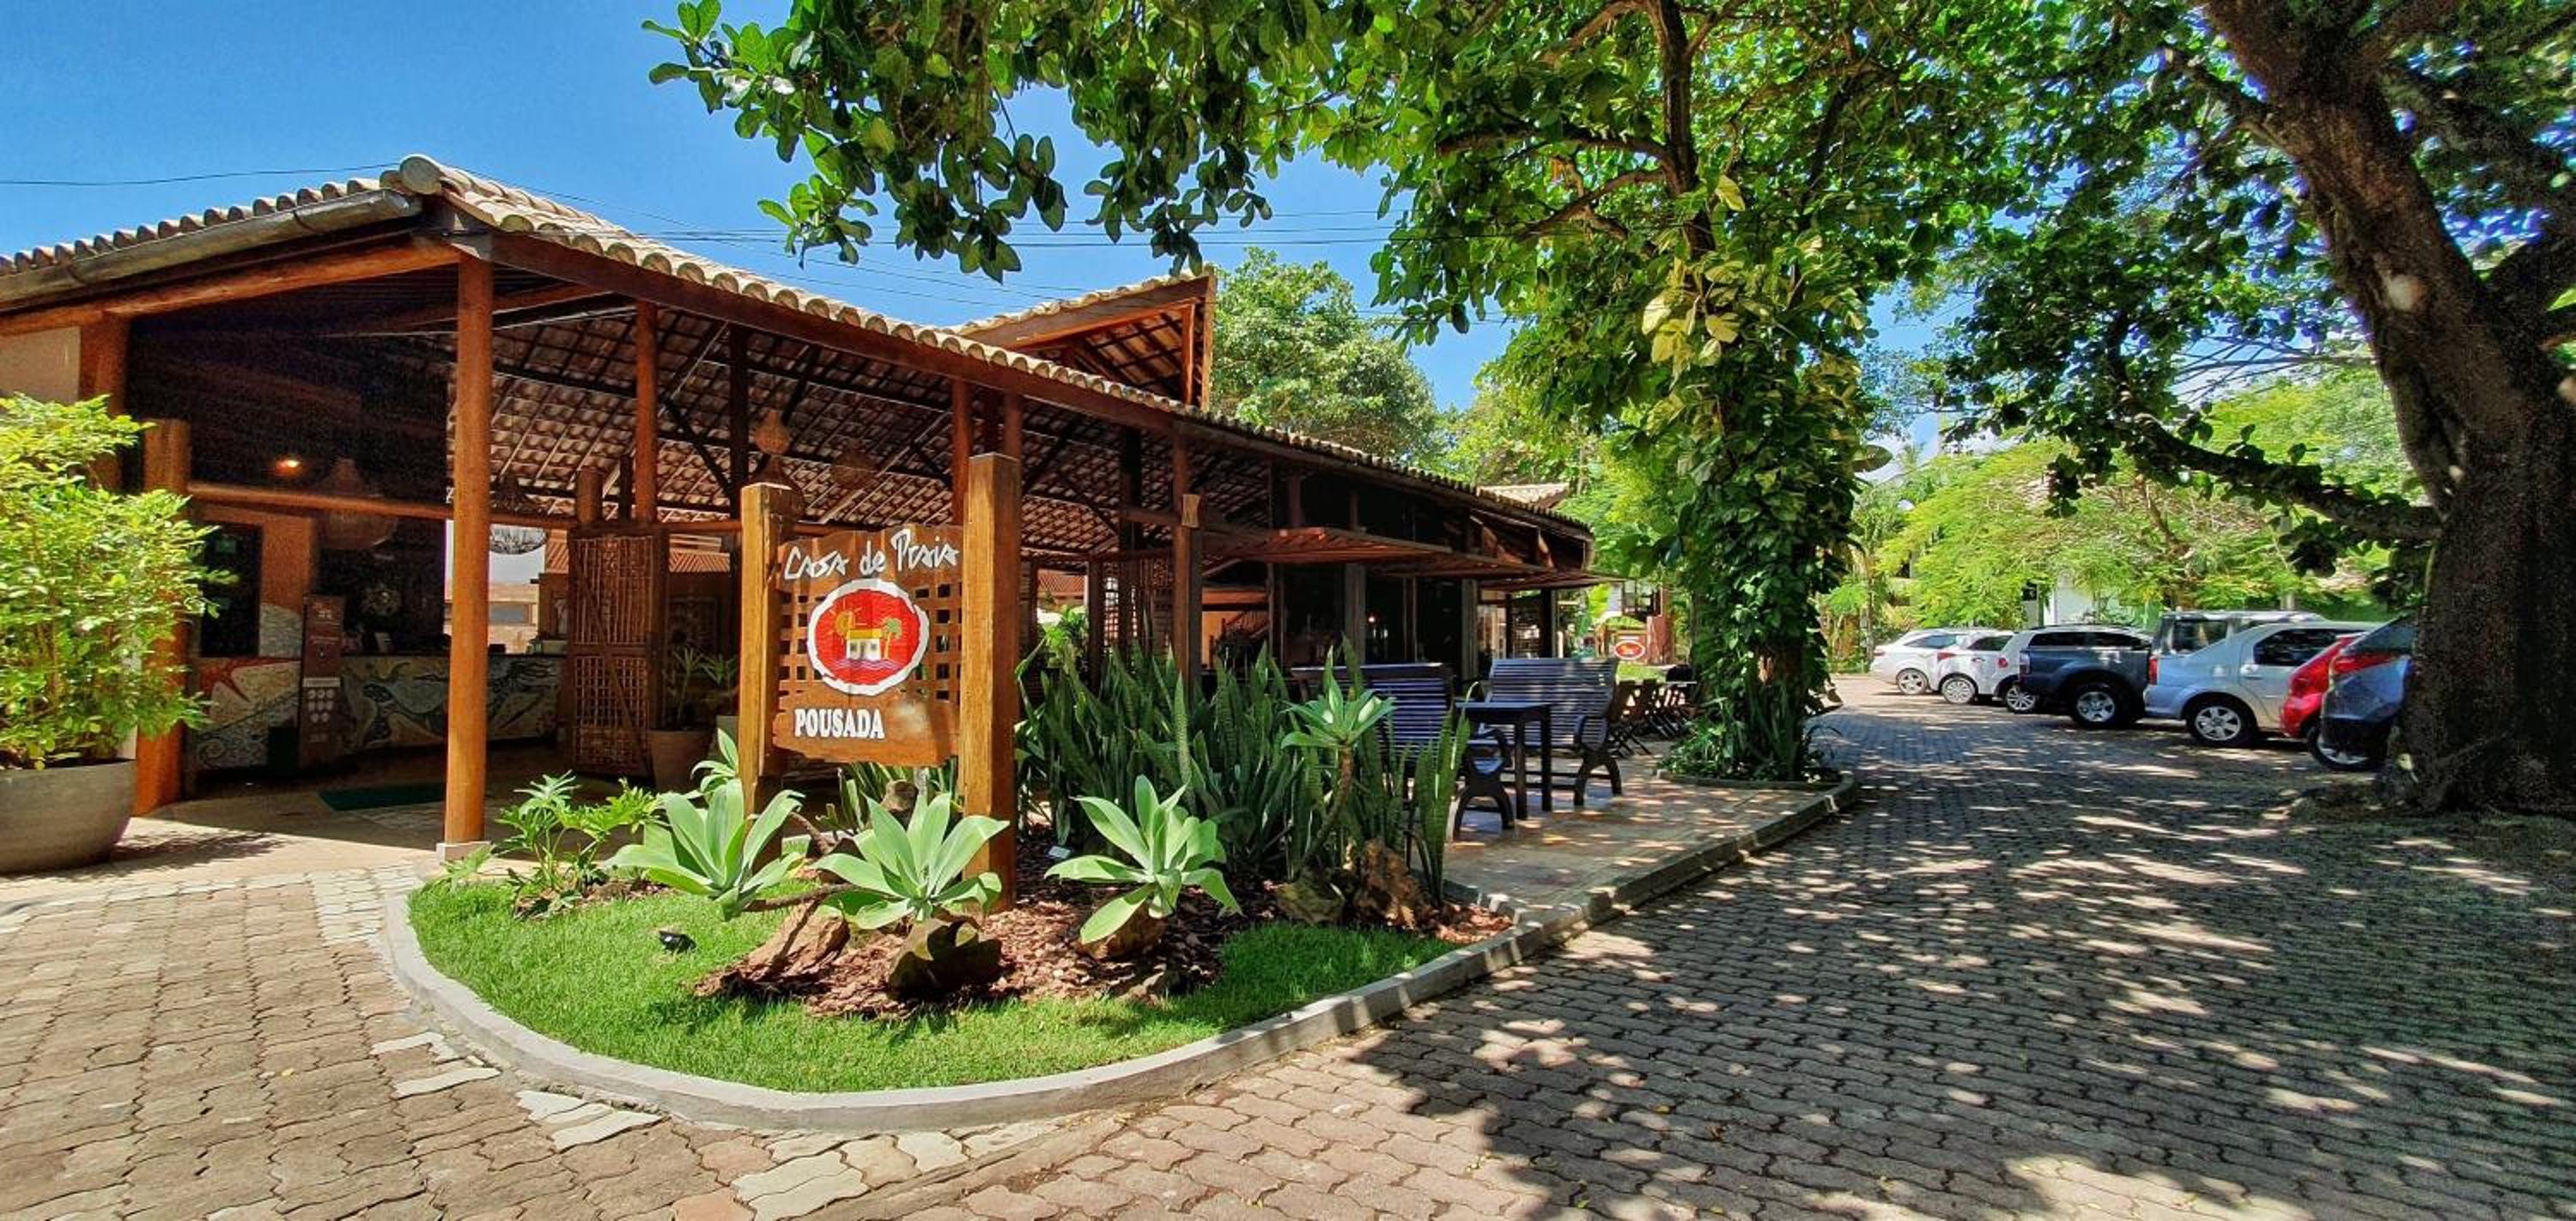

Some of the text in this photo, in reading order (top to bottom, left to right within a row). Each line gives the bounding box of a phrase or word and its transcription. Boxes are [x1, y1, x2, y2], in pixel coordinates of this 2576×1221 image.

[784, 528, 960, 580] Casa de Praia
[794, 708, 885, 738] POUSADA
